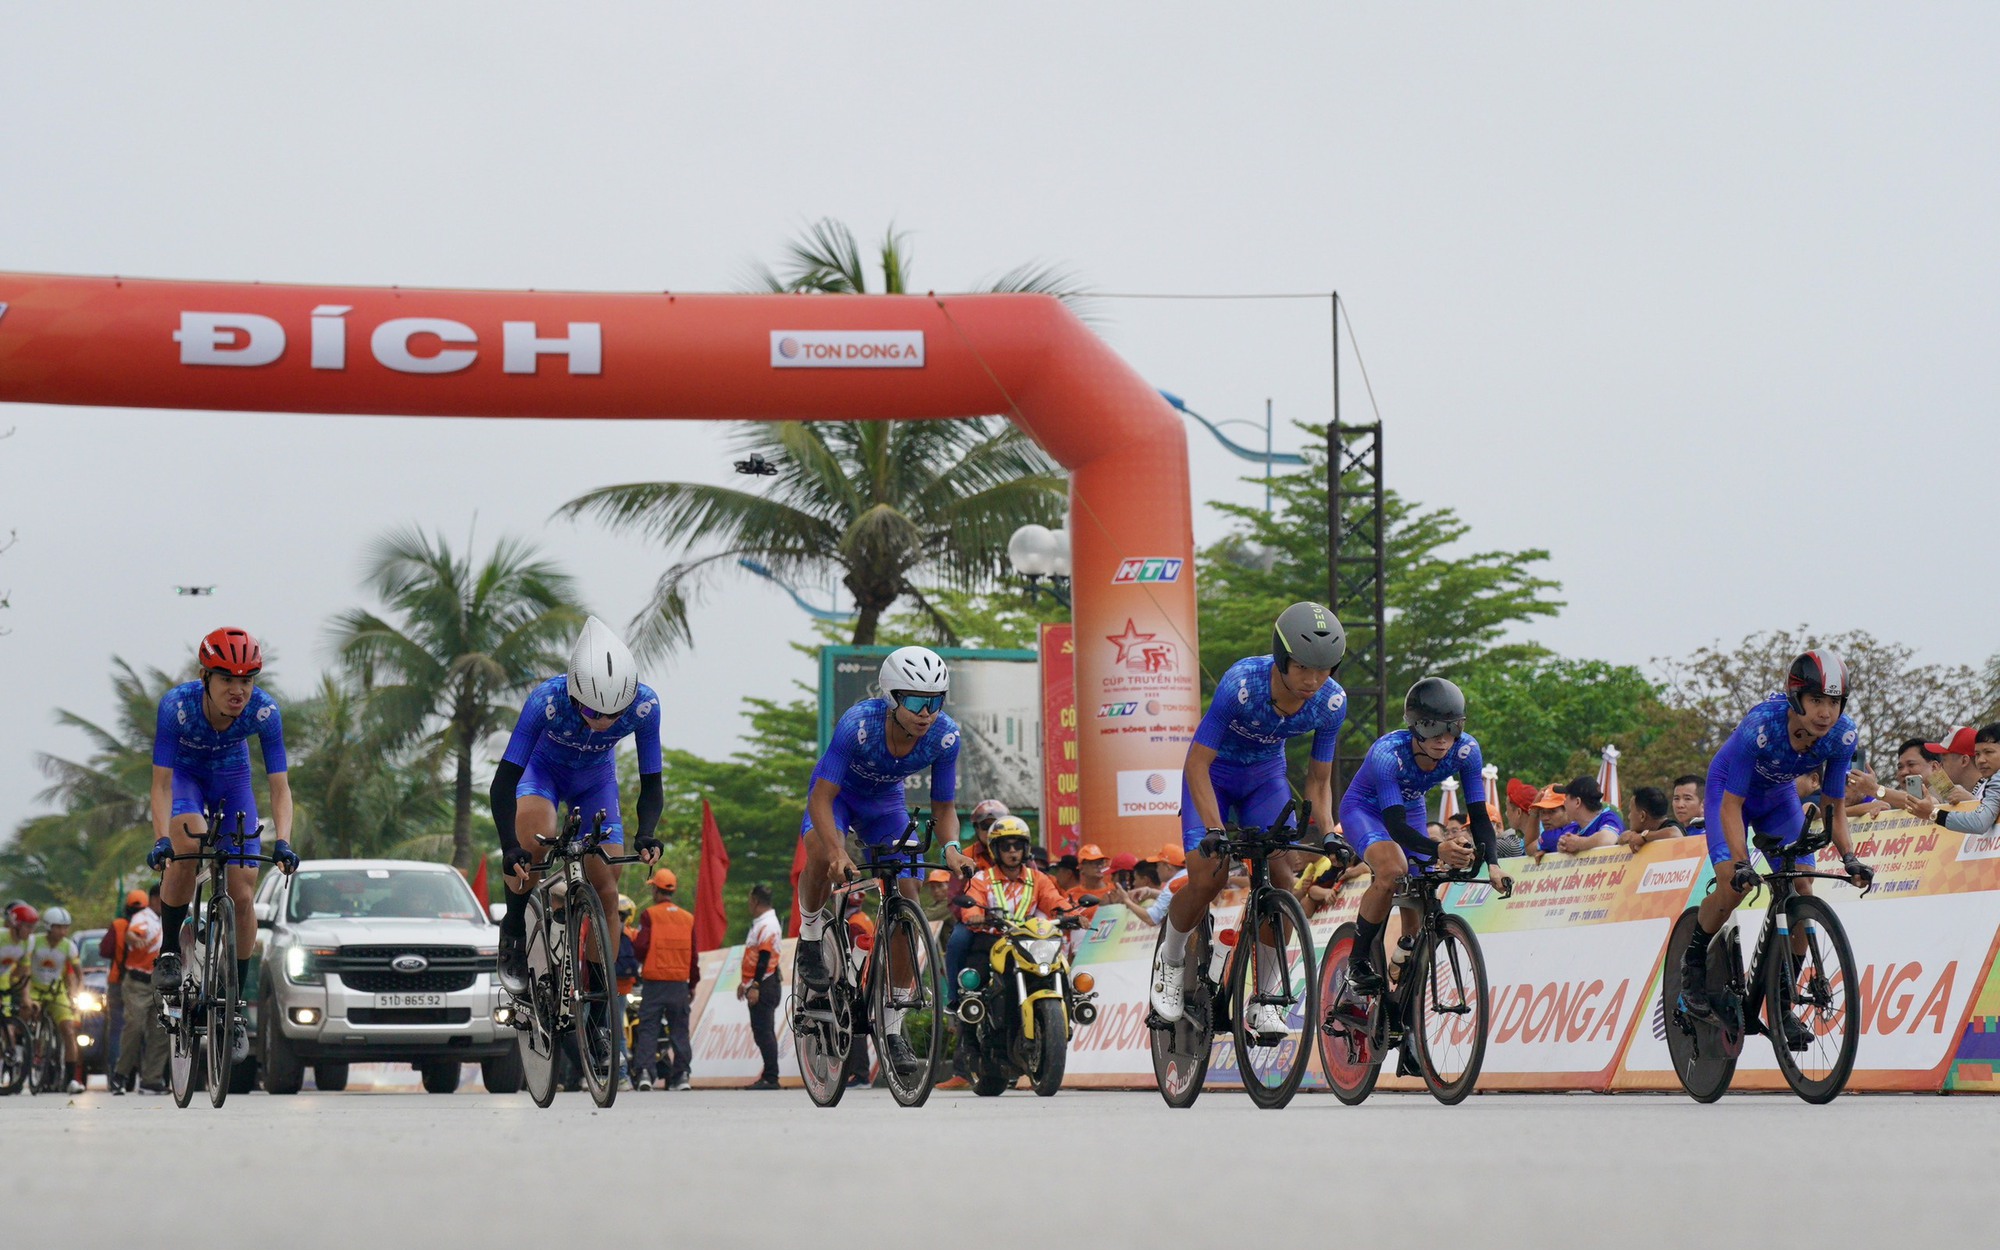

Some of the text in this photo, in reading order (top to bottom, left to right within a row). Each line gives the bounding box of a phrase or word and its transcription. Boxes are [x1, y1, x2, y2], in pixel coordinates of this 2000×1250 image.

[173, 304, 601, 375] ĐÍCH
[802, 344, 917, 359] TON DONG A
[1115, 560, 1182, 581] HTV
[1098, 702, 1138, 717] HTV
[1123, 801, 1178, 812] TON DONG
[1881, 832, 1914, 859] MỘT
[1974, 836, 1996, 853] TON
[1651, 872, 1668, 886] TON
[1664, 870, 1687, 884] DONG
[1906, 960, 1958, 1034] A
[1495, 979, 1605, 1044] DONG
[1587, 978, 1630, 1042] A
